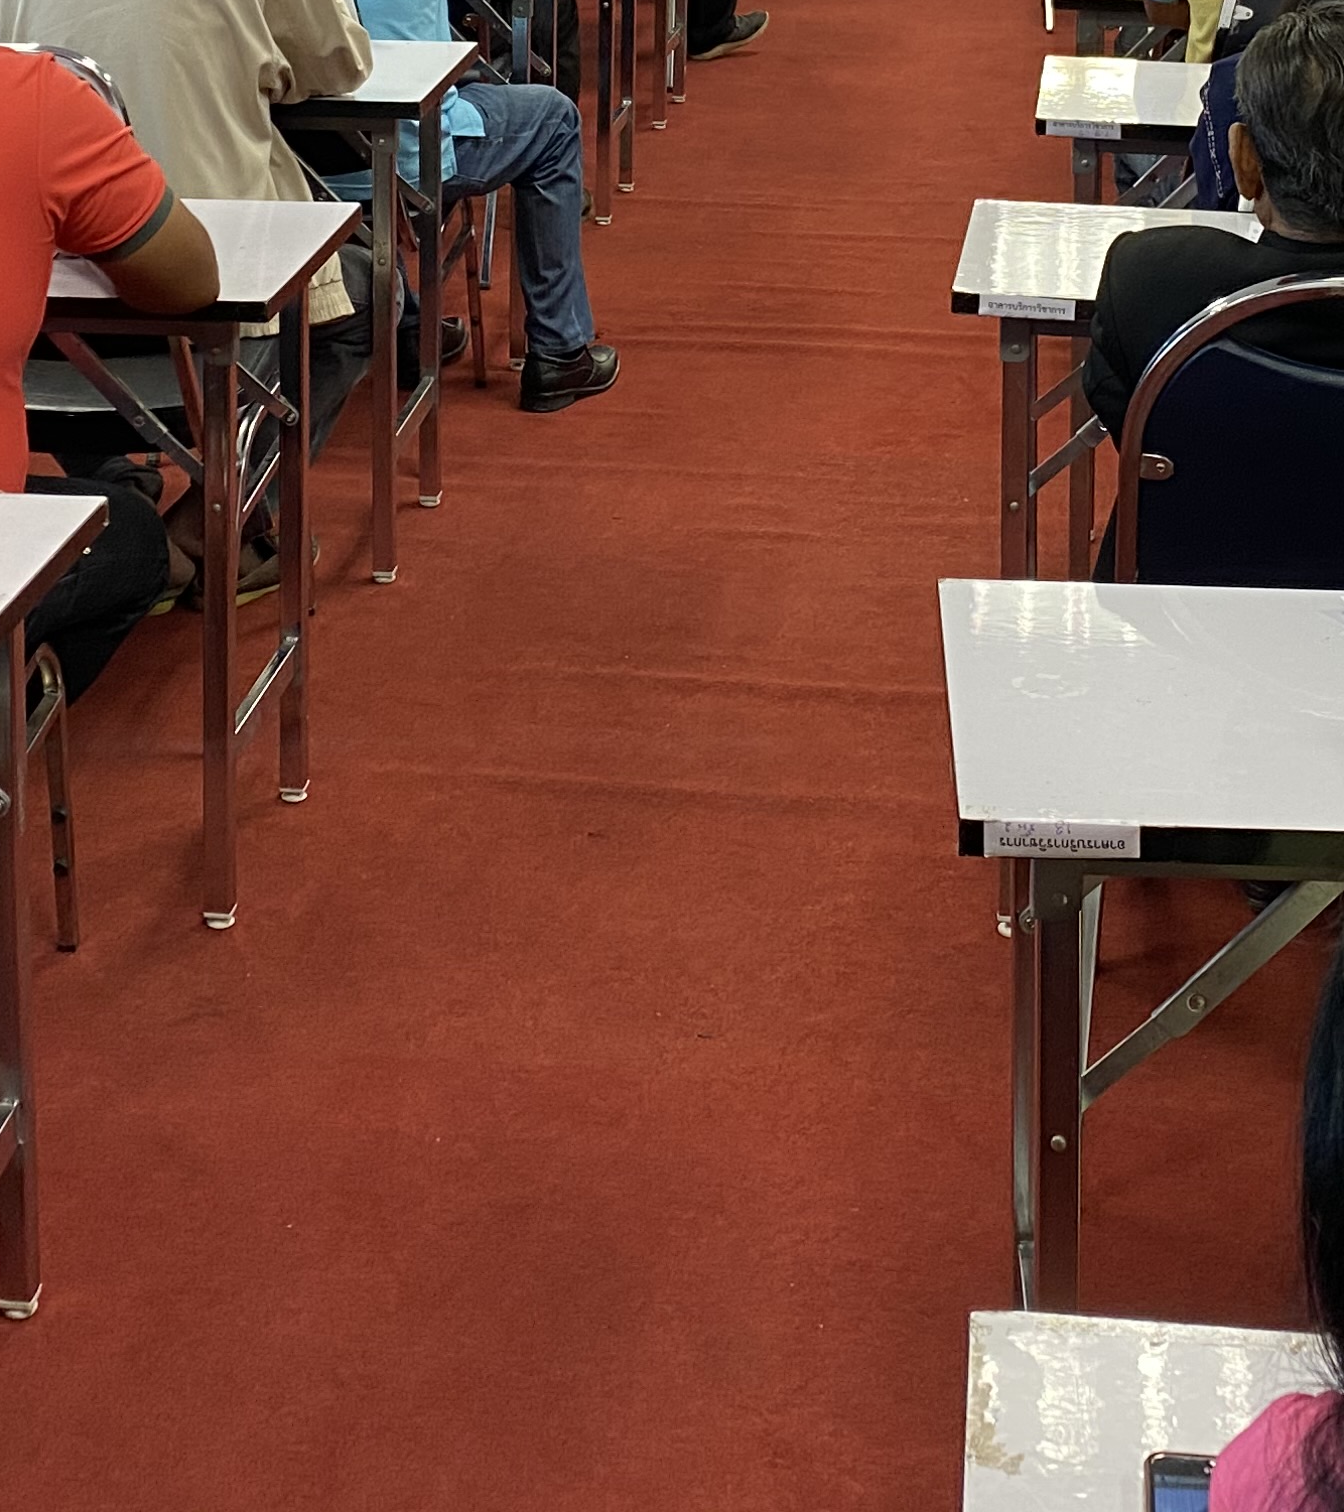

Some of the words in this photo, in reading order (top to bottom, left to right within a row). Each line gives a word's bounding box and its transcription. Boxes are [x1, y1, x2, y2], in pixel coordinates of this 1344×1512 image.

[999, 837, 1126, 853] อาคารบริการวิชาการ
